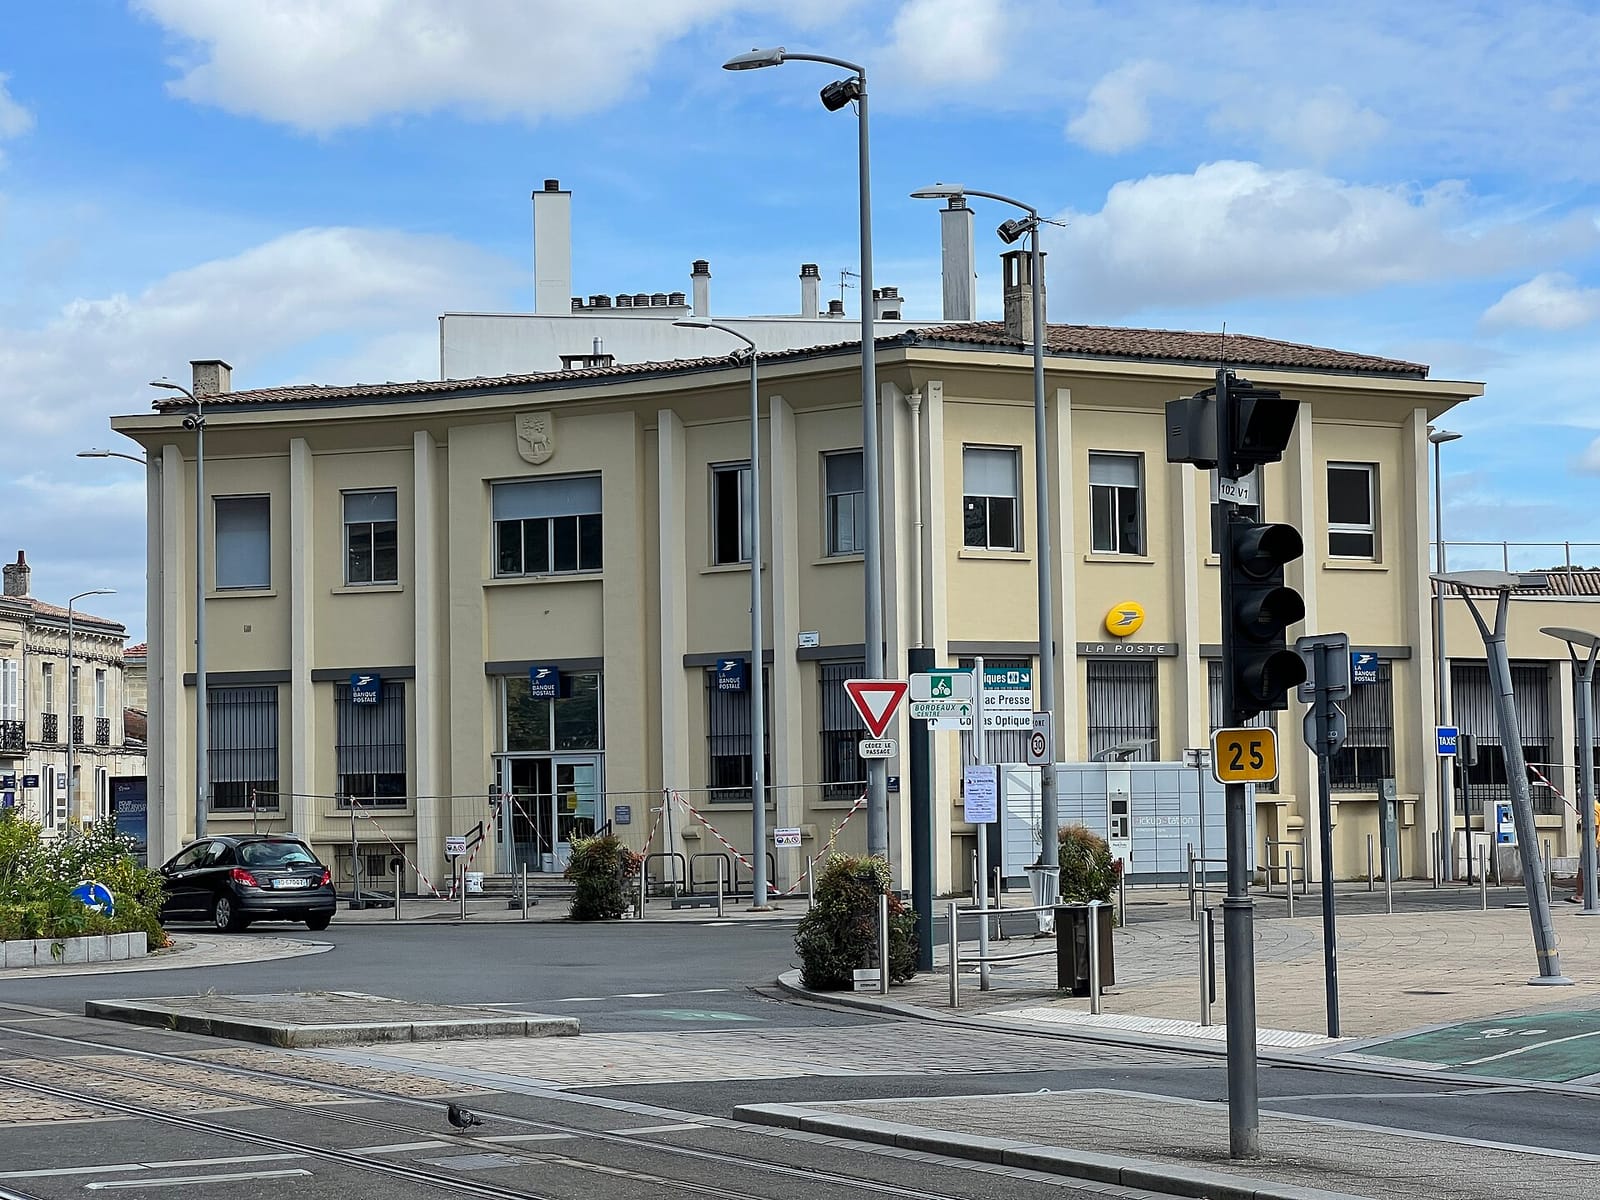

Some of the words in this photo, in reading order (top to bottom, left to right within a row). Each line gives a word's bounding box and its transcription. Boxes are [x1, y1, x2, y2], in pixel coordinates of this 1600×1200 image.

[1221, 484, 1235, 496] 102
[1238, 488, 1248, 499] V1
[1085, 644, 1104, 653] LA
[1115, 645, 1166, 653] POSTE
[983, 673, 1006, 684] iques
[999, 695, 1030, 705] Presse
[995, 715, 1030, 727] Optique
[1033, 739, 1043, 750] 30
[1228, 741, 1264, 771] 25
